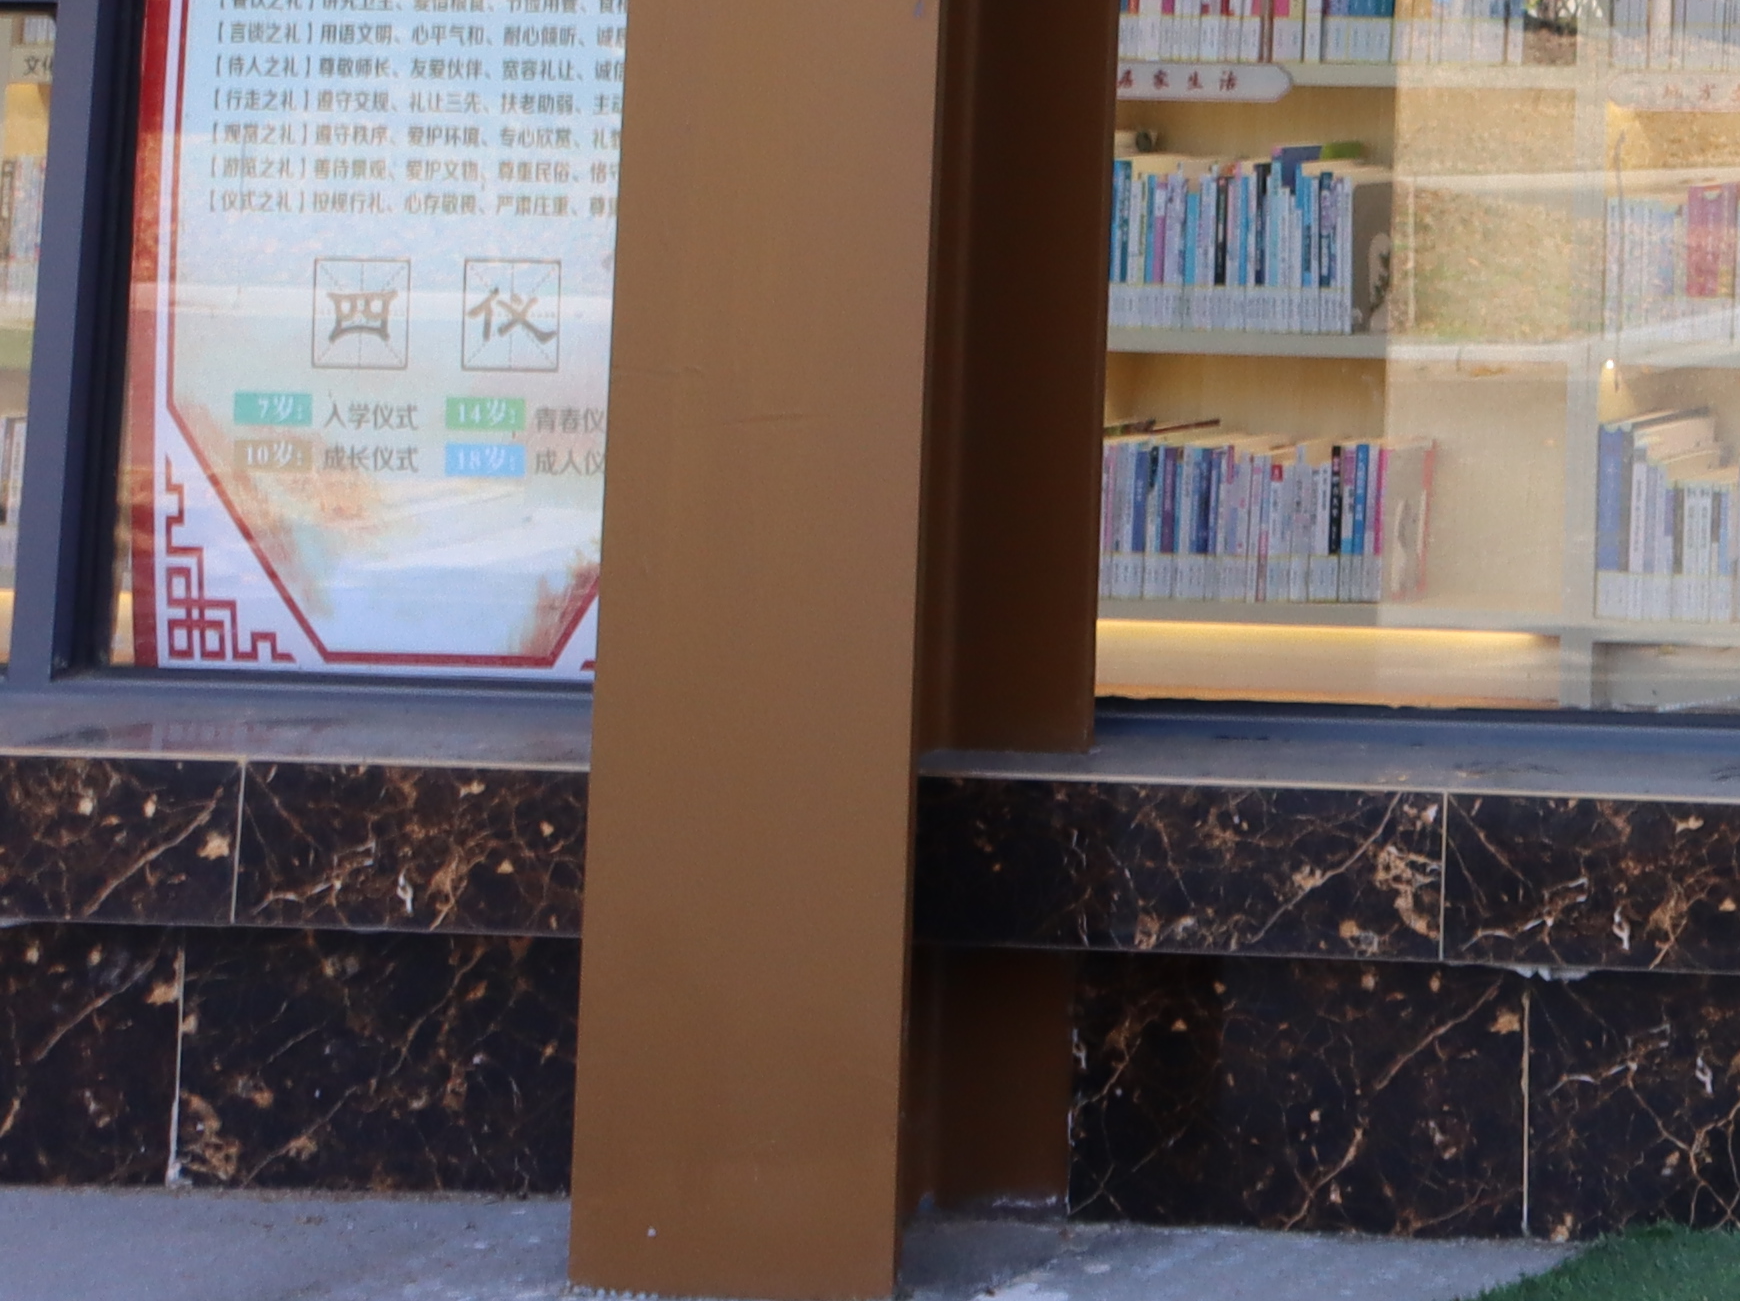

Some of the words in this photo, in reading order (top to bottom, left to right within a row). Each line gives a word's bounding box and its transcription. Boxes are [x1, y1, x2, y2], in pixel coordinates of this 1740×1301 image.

[323, 402, 420, 431] 入学仪式
[323, 443, 420, 473] 成长仪式
